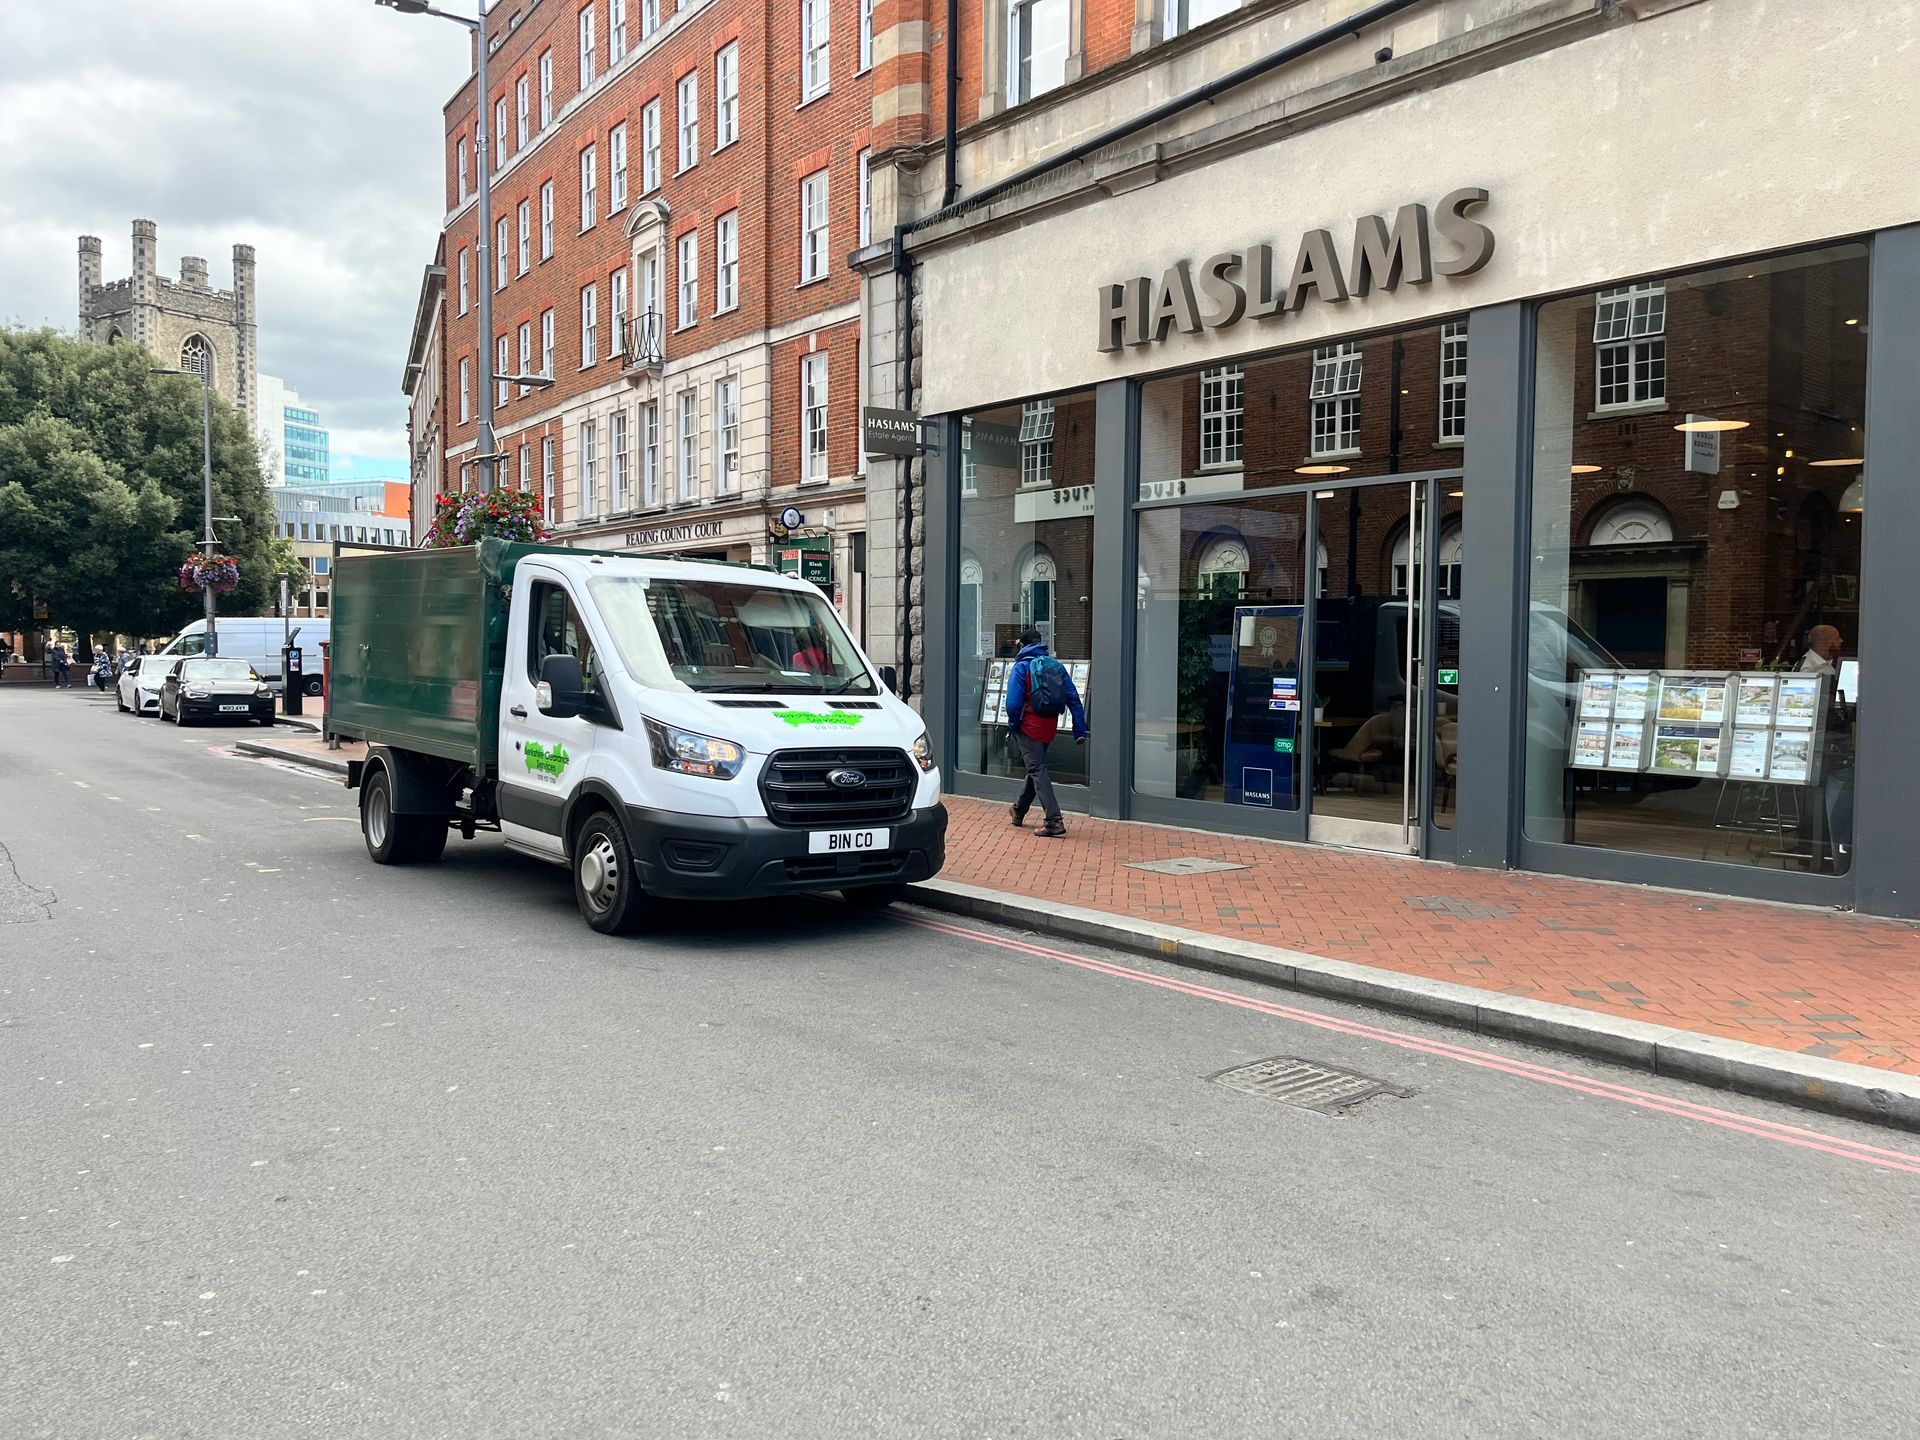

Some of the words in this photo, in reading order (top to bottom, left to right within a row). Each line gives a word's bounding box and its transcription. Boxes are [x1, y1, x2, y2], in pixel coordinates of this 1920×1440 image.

[1097, 187, 1495, 353] HASLAMS
[867, 418, 915, 432] HASLAMS
[868, 431, 889, 440] Estate
[891, 433, 915, 443] Agents
[625, 530, 659, 547] READING
[660, 525, 693, 542] COUNTY
[694, 521, 723, 538] COURT
[1277, 741, 1292, 749] cmp
[545, 751, 569, 764] Clearance
[537, 760, 555, 771] Services
[841, 772, 859, 783] Ford
[1244, 791, 1270, 799] HASLAMS
[828, 833, 851, 850] BIN
[855, 832, 873, 848] CO
